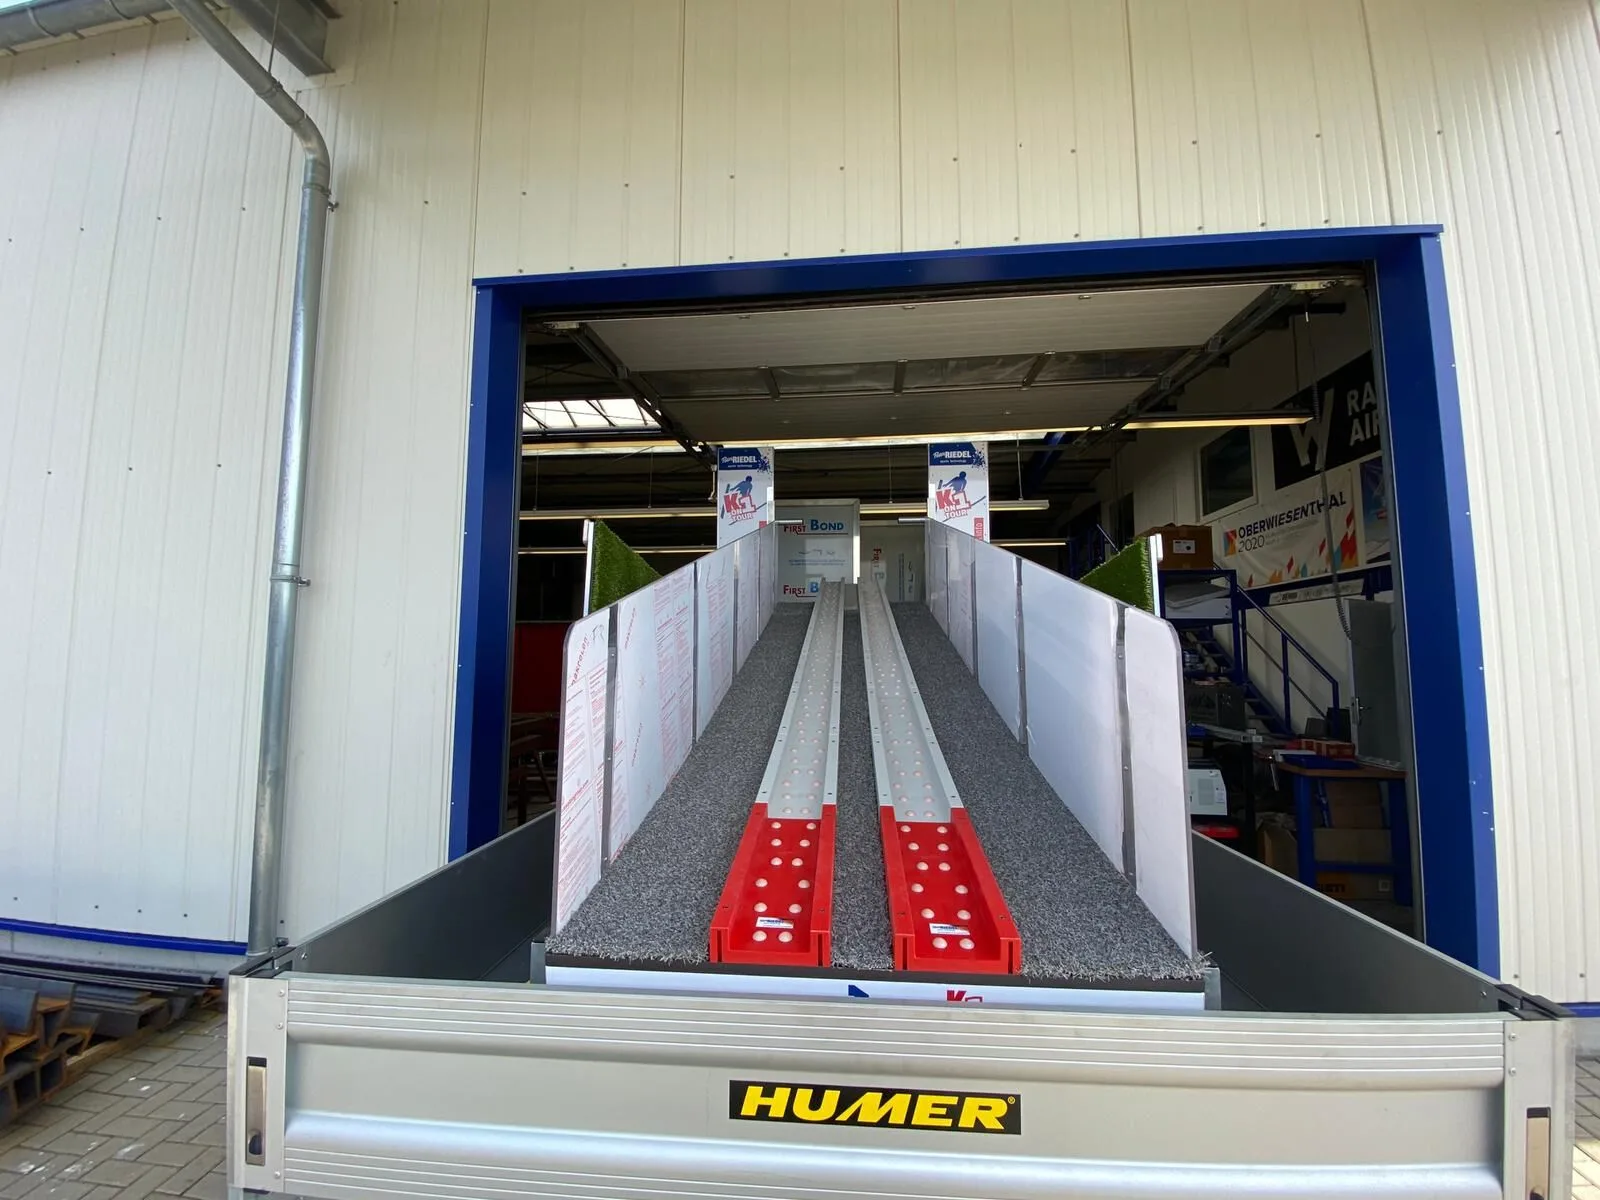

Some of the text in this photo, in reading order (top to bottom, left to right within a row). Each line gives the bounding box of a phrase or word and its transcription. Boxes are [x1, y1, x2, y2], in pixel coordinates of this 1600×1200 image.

[732, 455, 757, 463] RIEDEL
[945, 450, 972, 459] RIEDEL
[731, 512, 753, 522] TOUR
[944, 510, 968, 519] TOUR
[1238, 491, 1347, 539] OBERWIESENTHAL
[810, 519, 844, 531] BOND
[1238, 534, 1266, 553] 2020
[783, 584, 806, 598] FIRST
